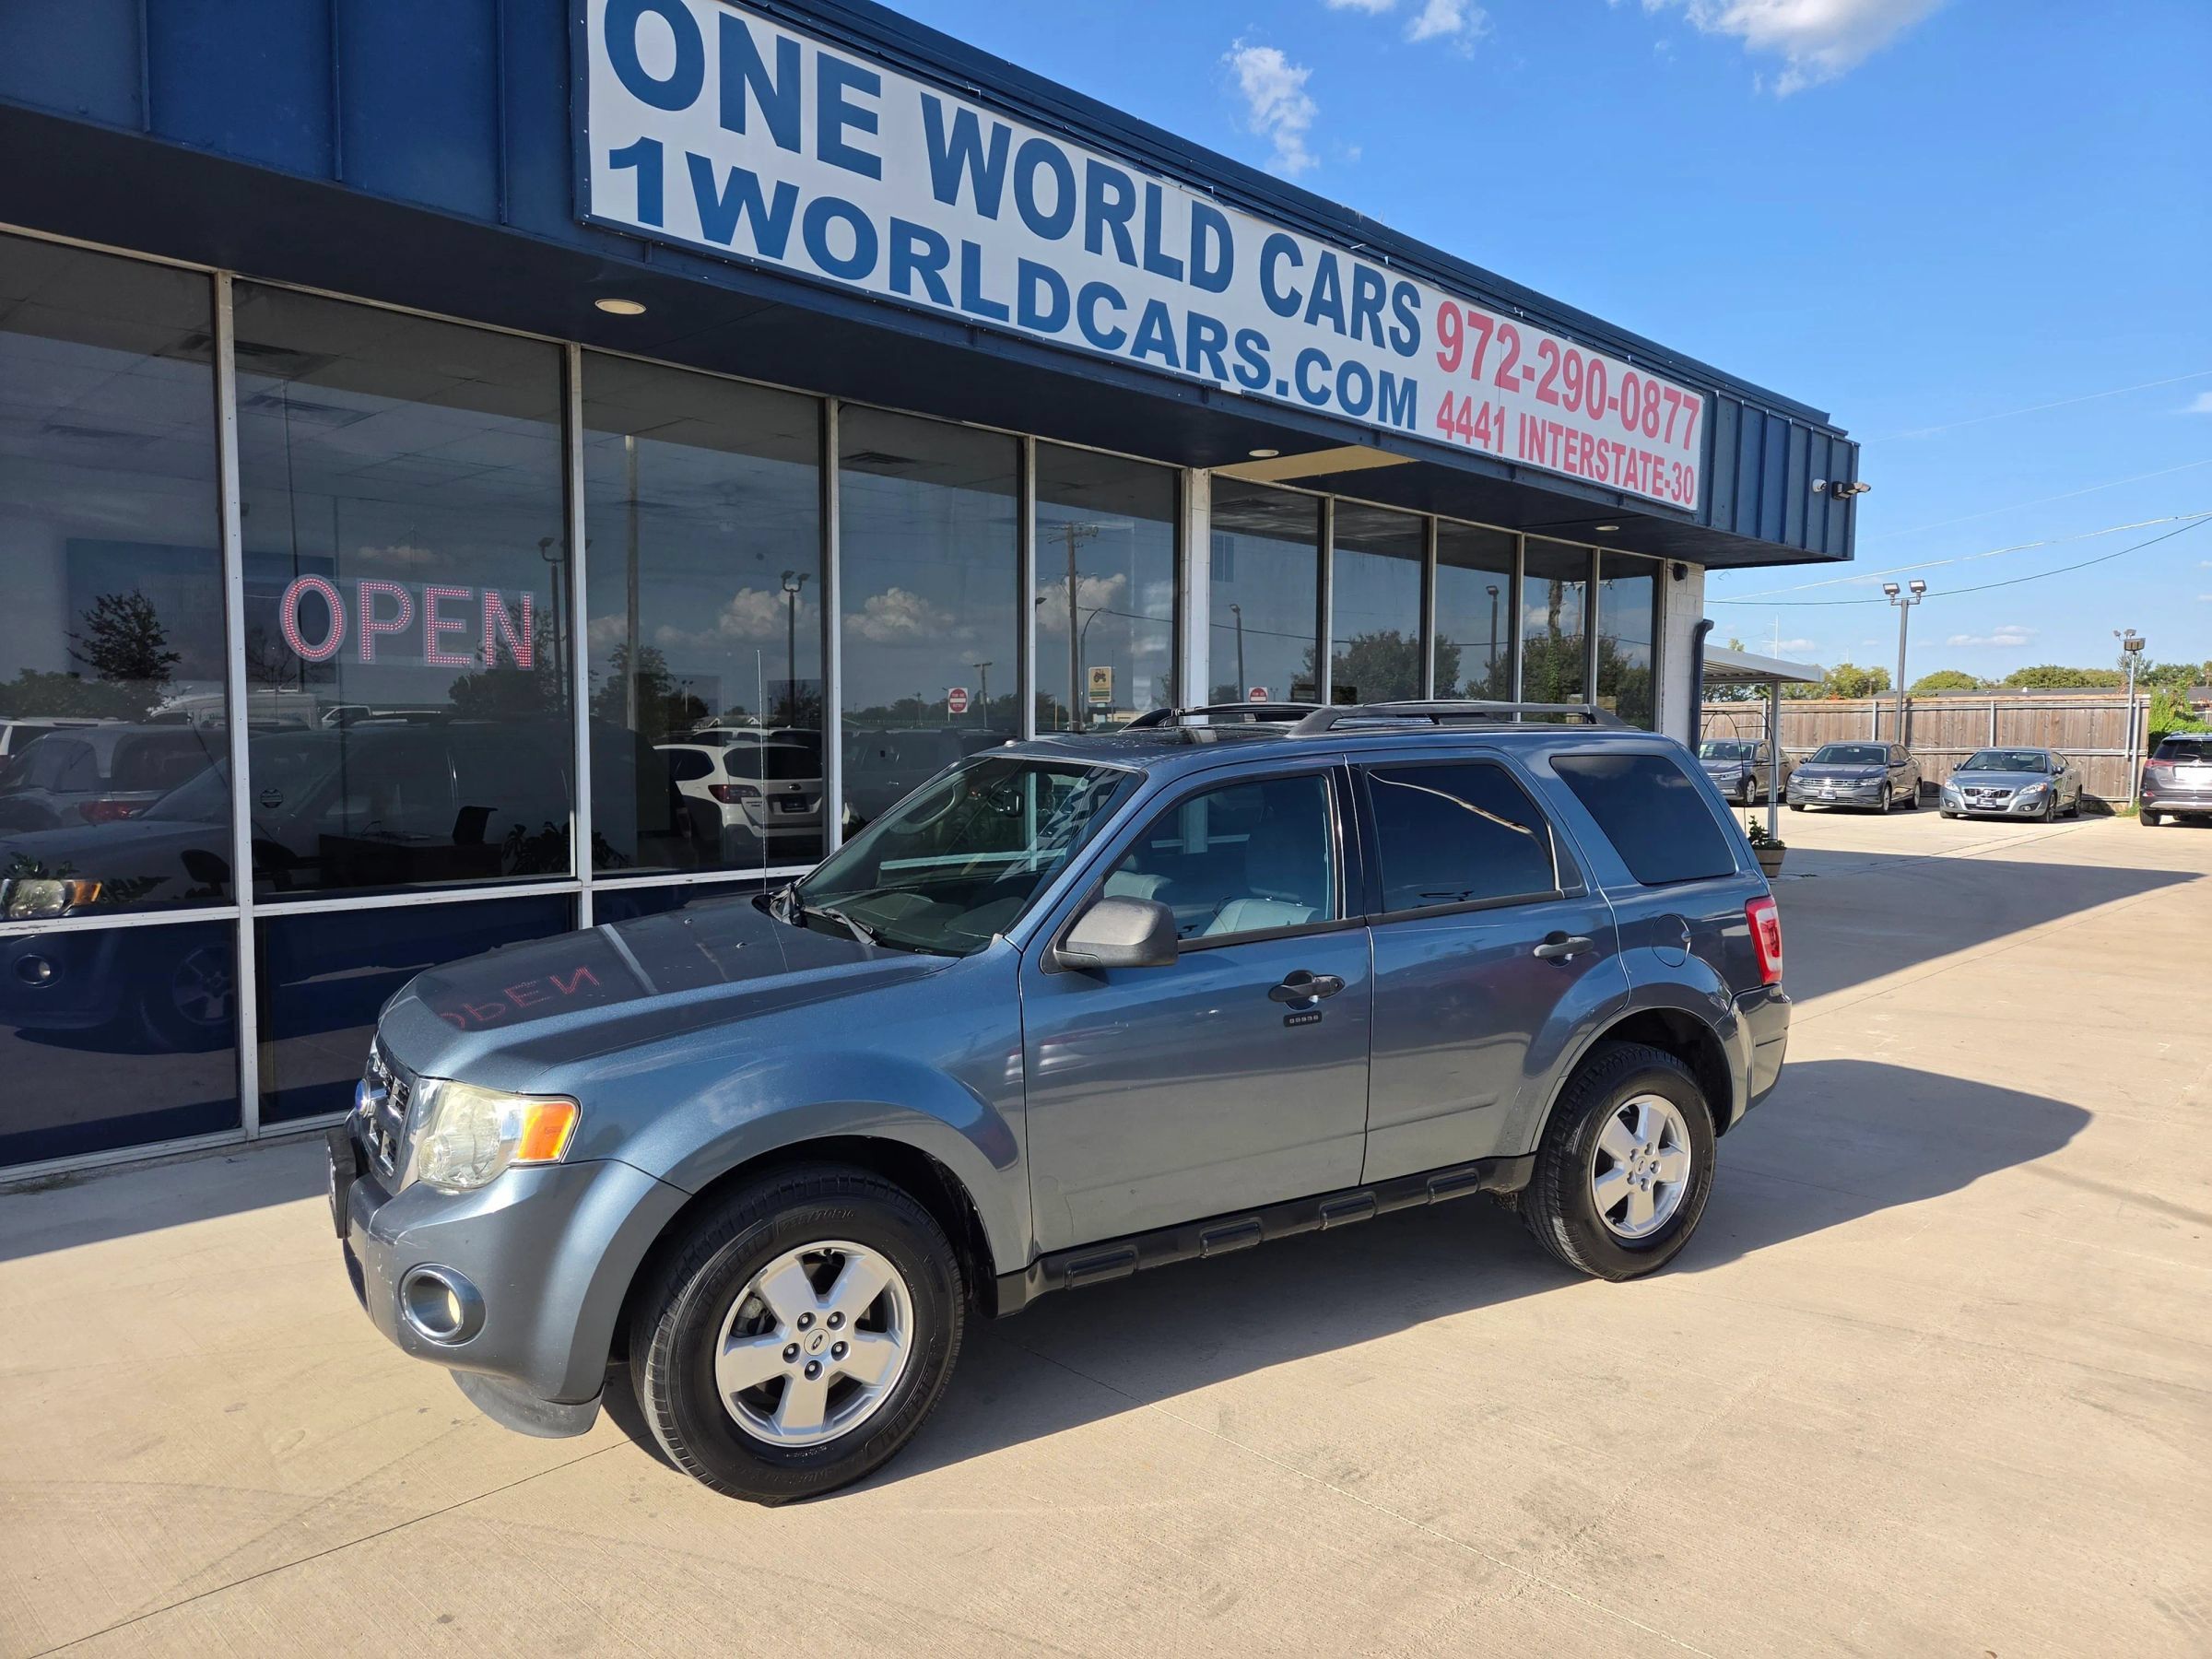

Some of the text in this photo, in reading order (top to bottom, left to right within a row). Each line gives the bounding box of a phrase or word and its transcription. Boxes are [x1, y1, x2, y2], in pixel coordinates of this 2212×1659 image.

[605, 0, 1421, 358] ONE WORLD CARS
[609, 135, 1418, 431] 1WORLDCARS.COM
[1435, 300, 1700, 451] 972-290-0877
[1436, 390, 1695, 505] 4441 INTERSTATE-30
[279, 573, 534, 671] OPEN
